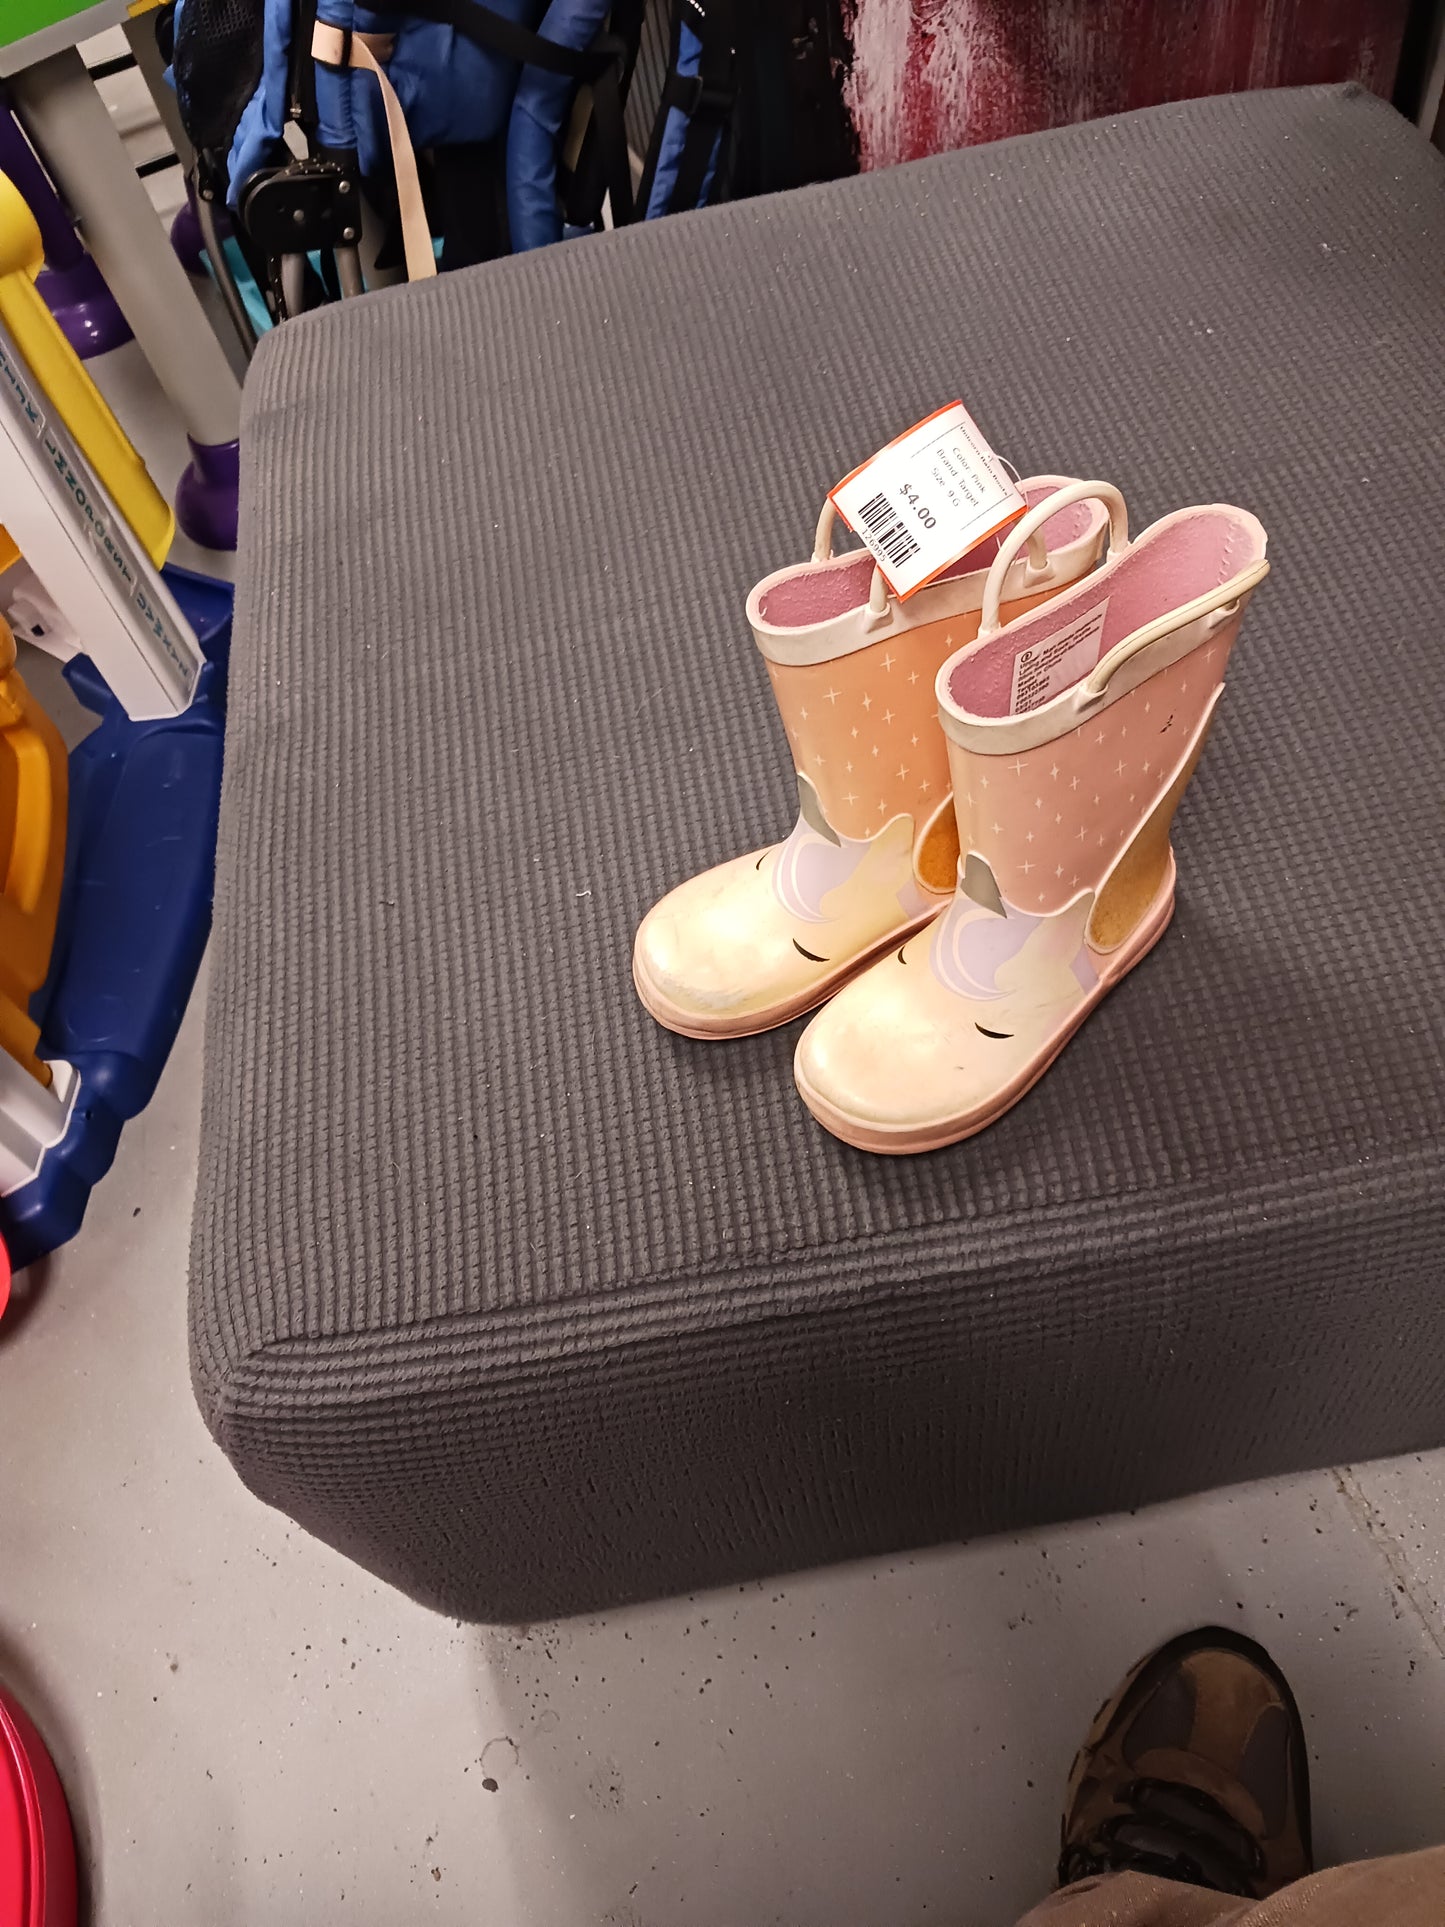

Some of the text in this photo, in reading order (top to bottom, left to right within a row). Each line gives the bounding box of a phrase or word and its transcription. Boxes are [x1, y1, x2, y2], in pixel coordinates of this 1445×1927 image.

[947, 489, 955, 498] 9
[958, 478, 979, 507] Target
[970, 473, 985, 494] Pink
[898, 483, 937, 529] $4.00
